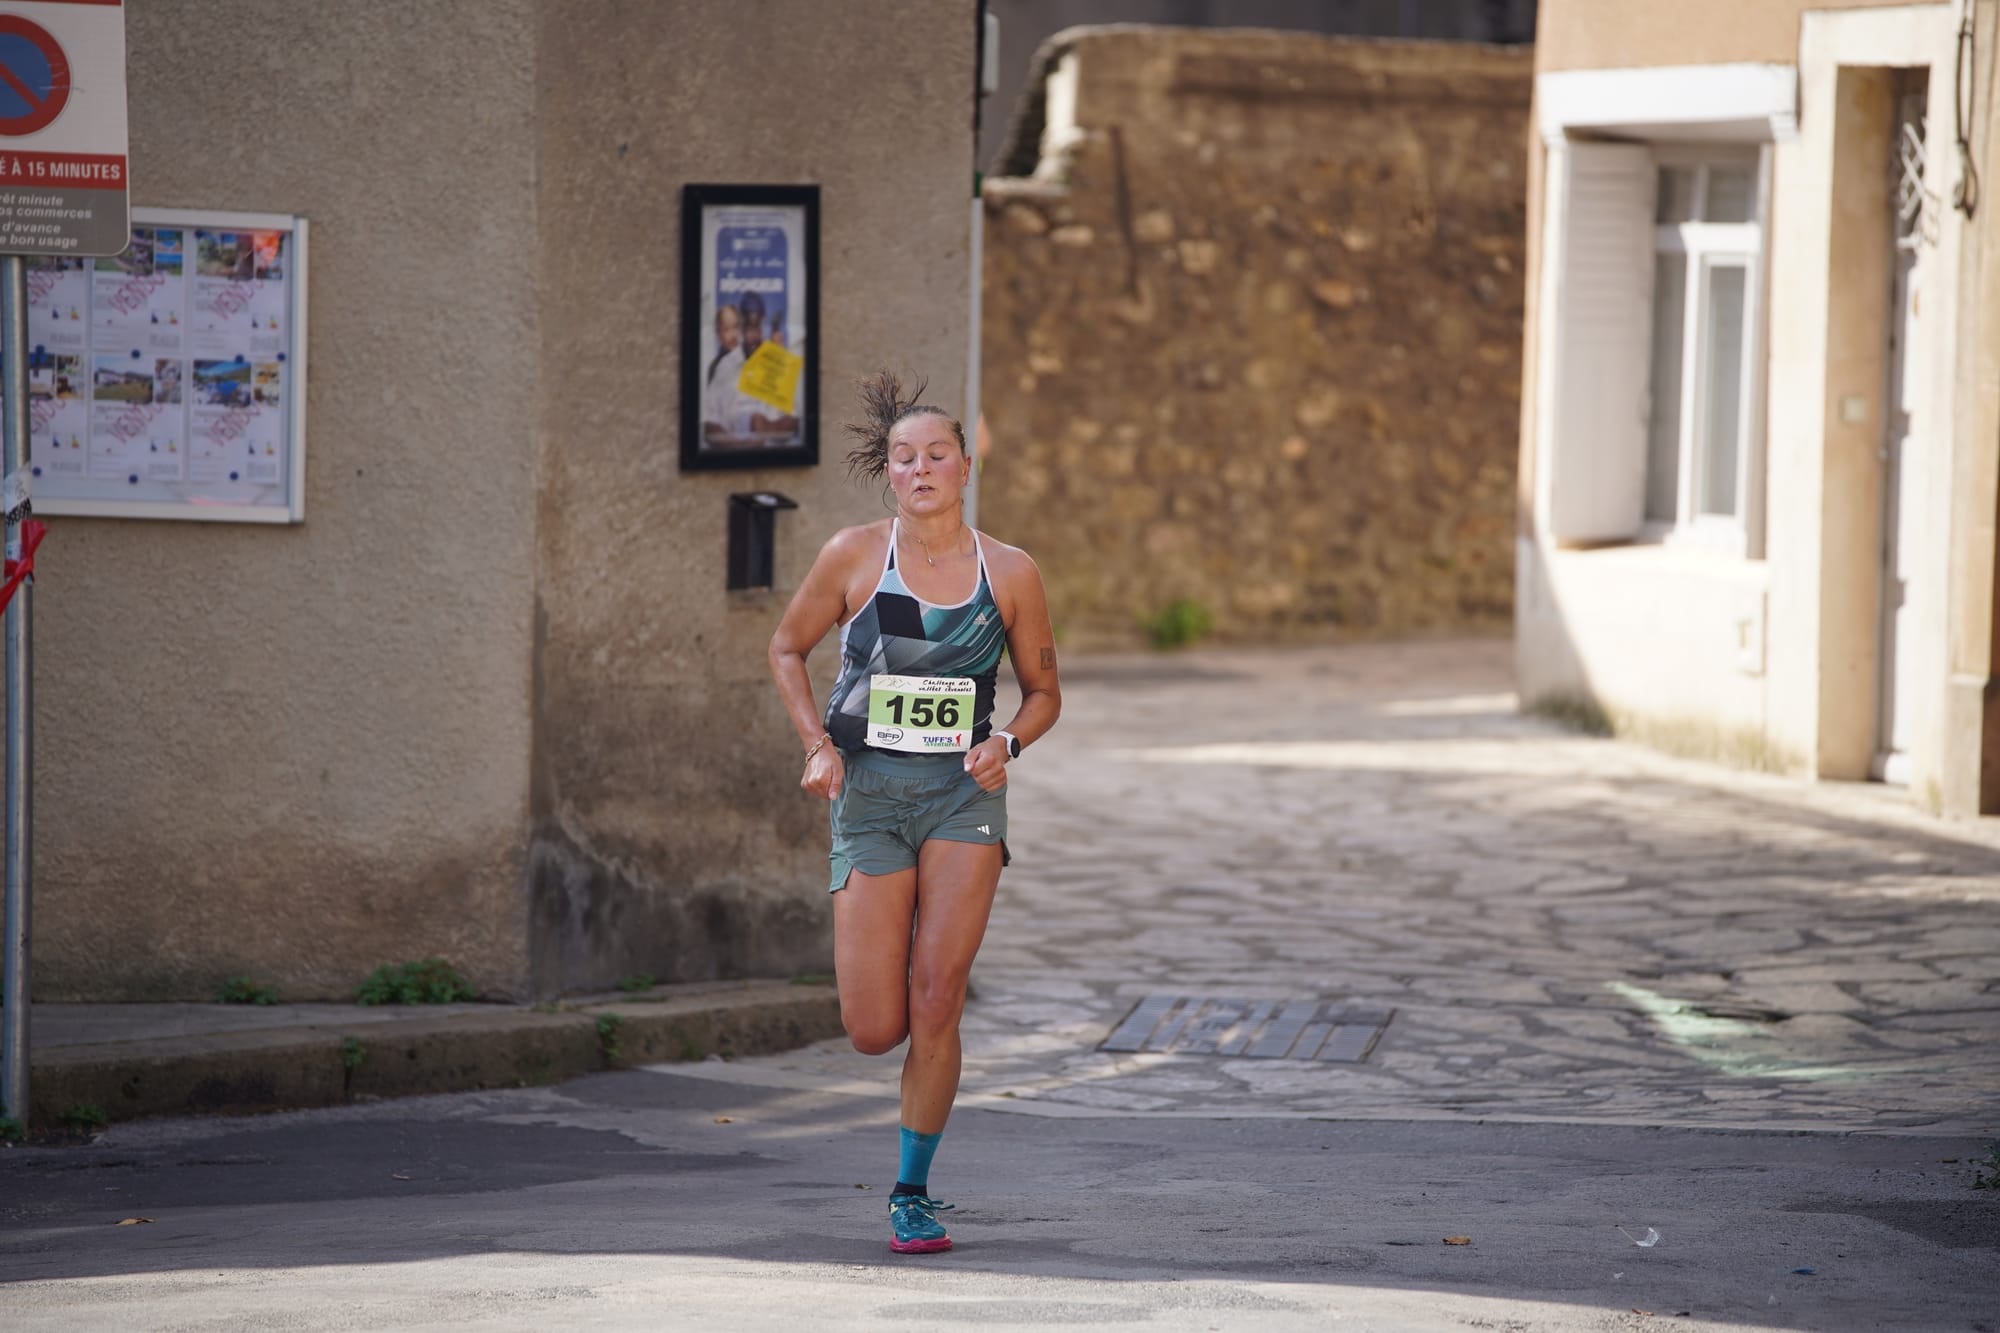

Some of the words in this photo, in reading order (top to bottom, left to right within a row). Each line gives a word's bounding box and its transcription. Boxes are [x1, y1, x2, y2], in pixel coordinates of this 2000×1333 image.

[11, 157, 22, 176] À
[27, 161, 45, 177] 15
[49, 161, 121, 180] MINUTES
[18, 193, 64, 207] minute
[16, 206, 93, 219] commerces
[2, 221, 61, 234] d'avance
[9, 233, 35, 246] bon
[38, 237, 78, 249] usage
[922, 679, 955, 688] Challenge
[886, 695, 960, 728] 156
